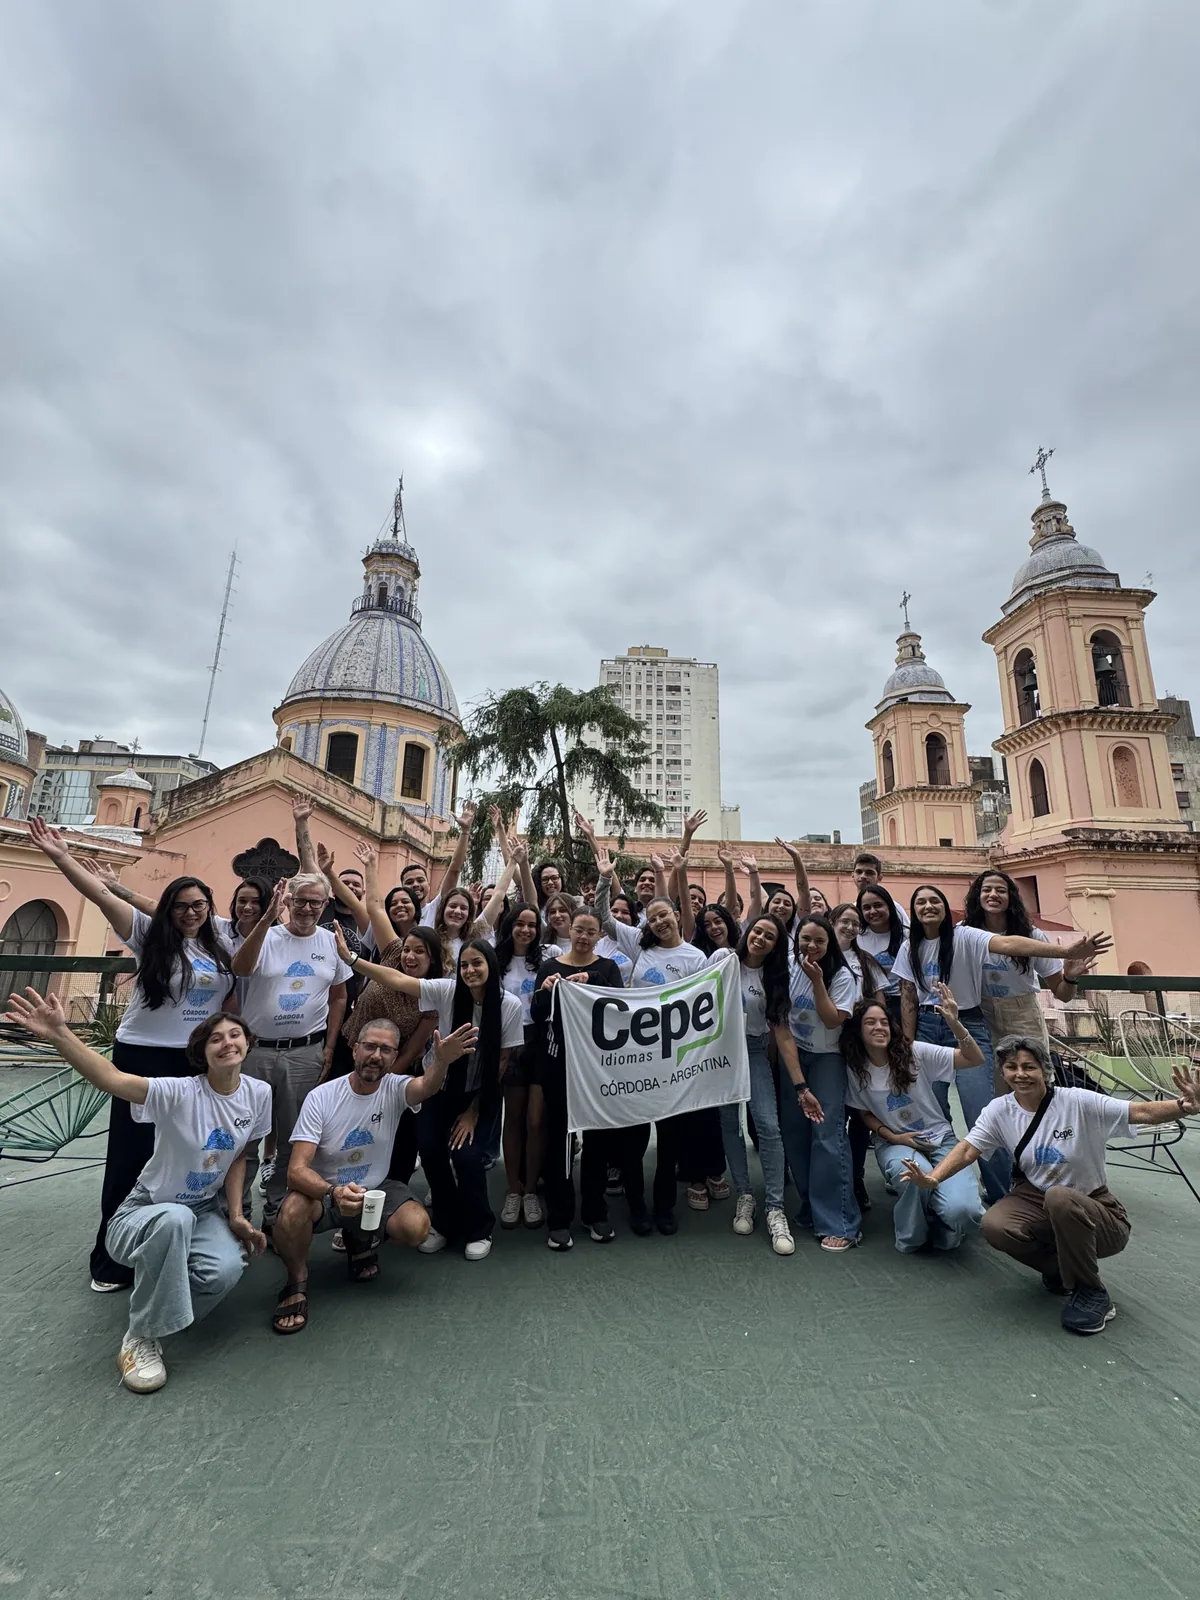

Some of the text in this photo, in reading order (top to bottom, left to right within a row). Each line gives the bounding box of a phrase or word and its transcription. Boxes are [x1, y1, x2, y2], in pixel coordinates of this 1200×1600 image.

[665, 963, 680, 973] Cepe
[591, 991, 715, 1060] Cepe
[601, 1051, 653, 1066] Idiomas
[600, 1078, 660, 1097] CÓRDOBA
[670, 1055, 731, 1085] ARGENTINA
[234, 1117, 250, 1129] Cepe
[1053, 1129, 1073, 1140] Cepe
